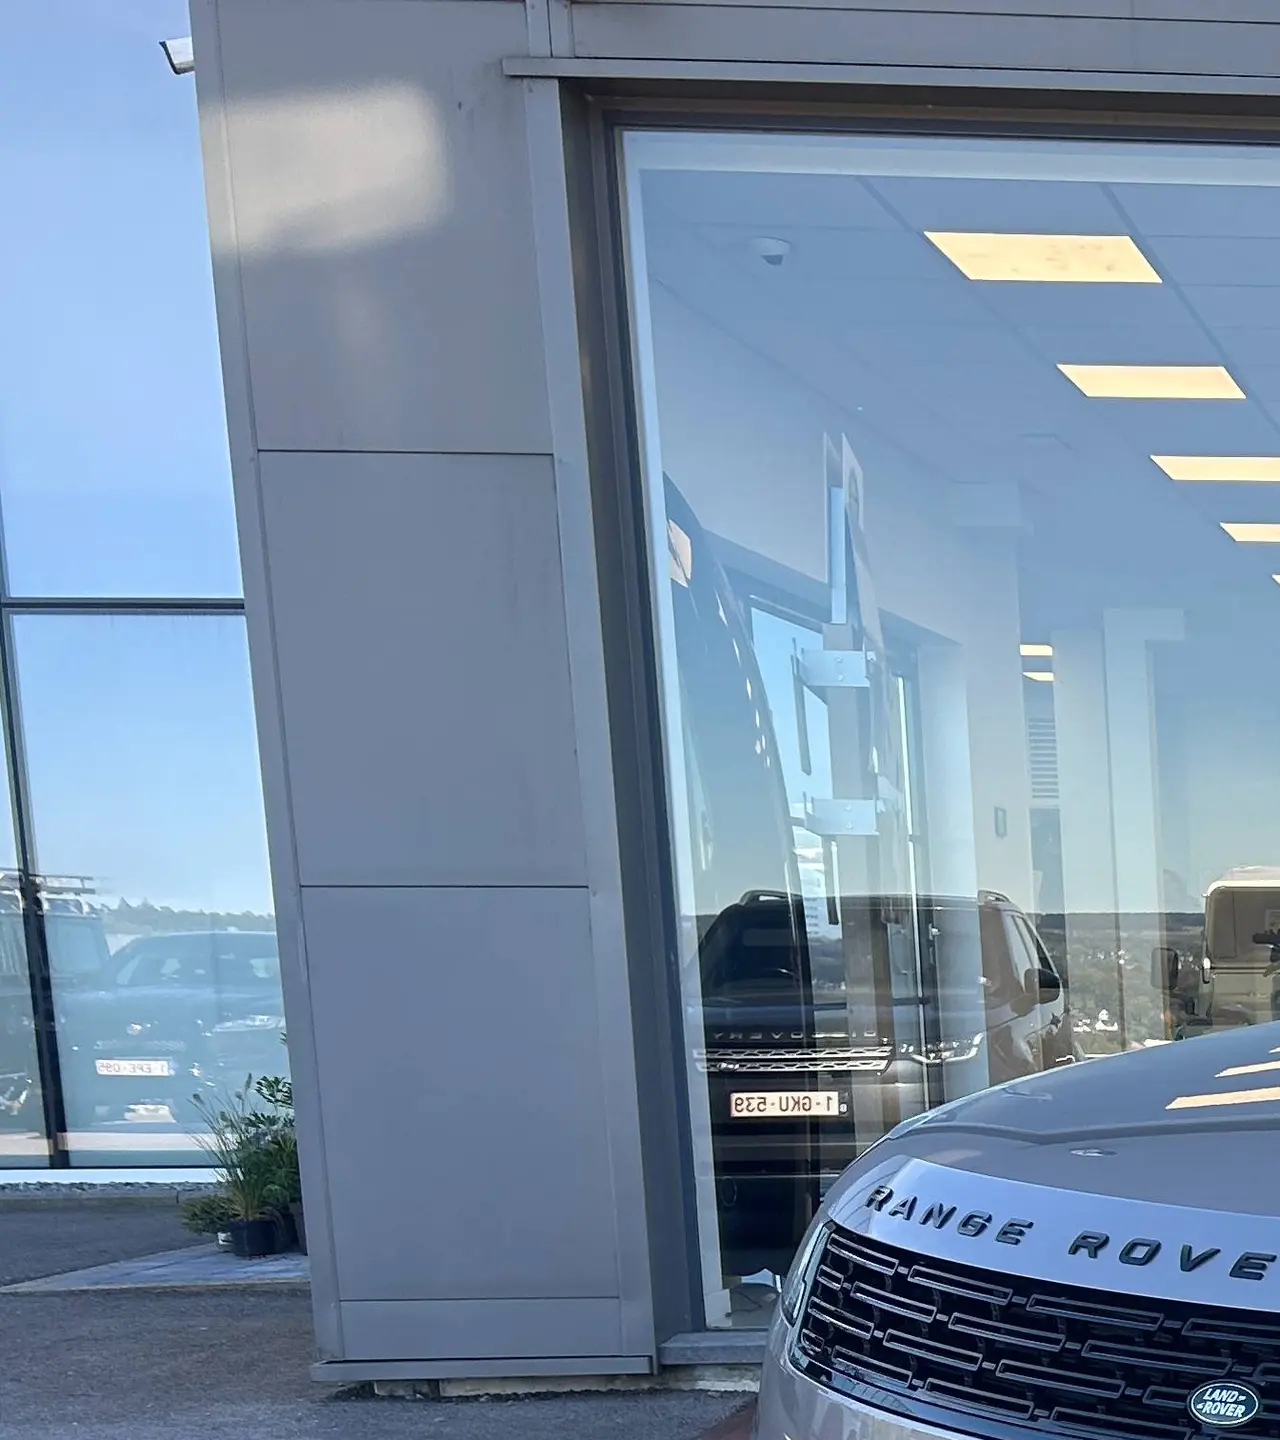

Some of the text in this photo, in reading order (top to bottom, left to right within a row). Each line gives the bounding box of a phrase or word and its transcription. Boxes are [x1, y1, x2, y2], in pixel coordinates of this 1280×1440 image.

[865, 1185, 1034, 1246] RANGE
[1203, 1388, 1240, 1403] LAND
[1201, 1401, 1246, 1418] ROVER
